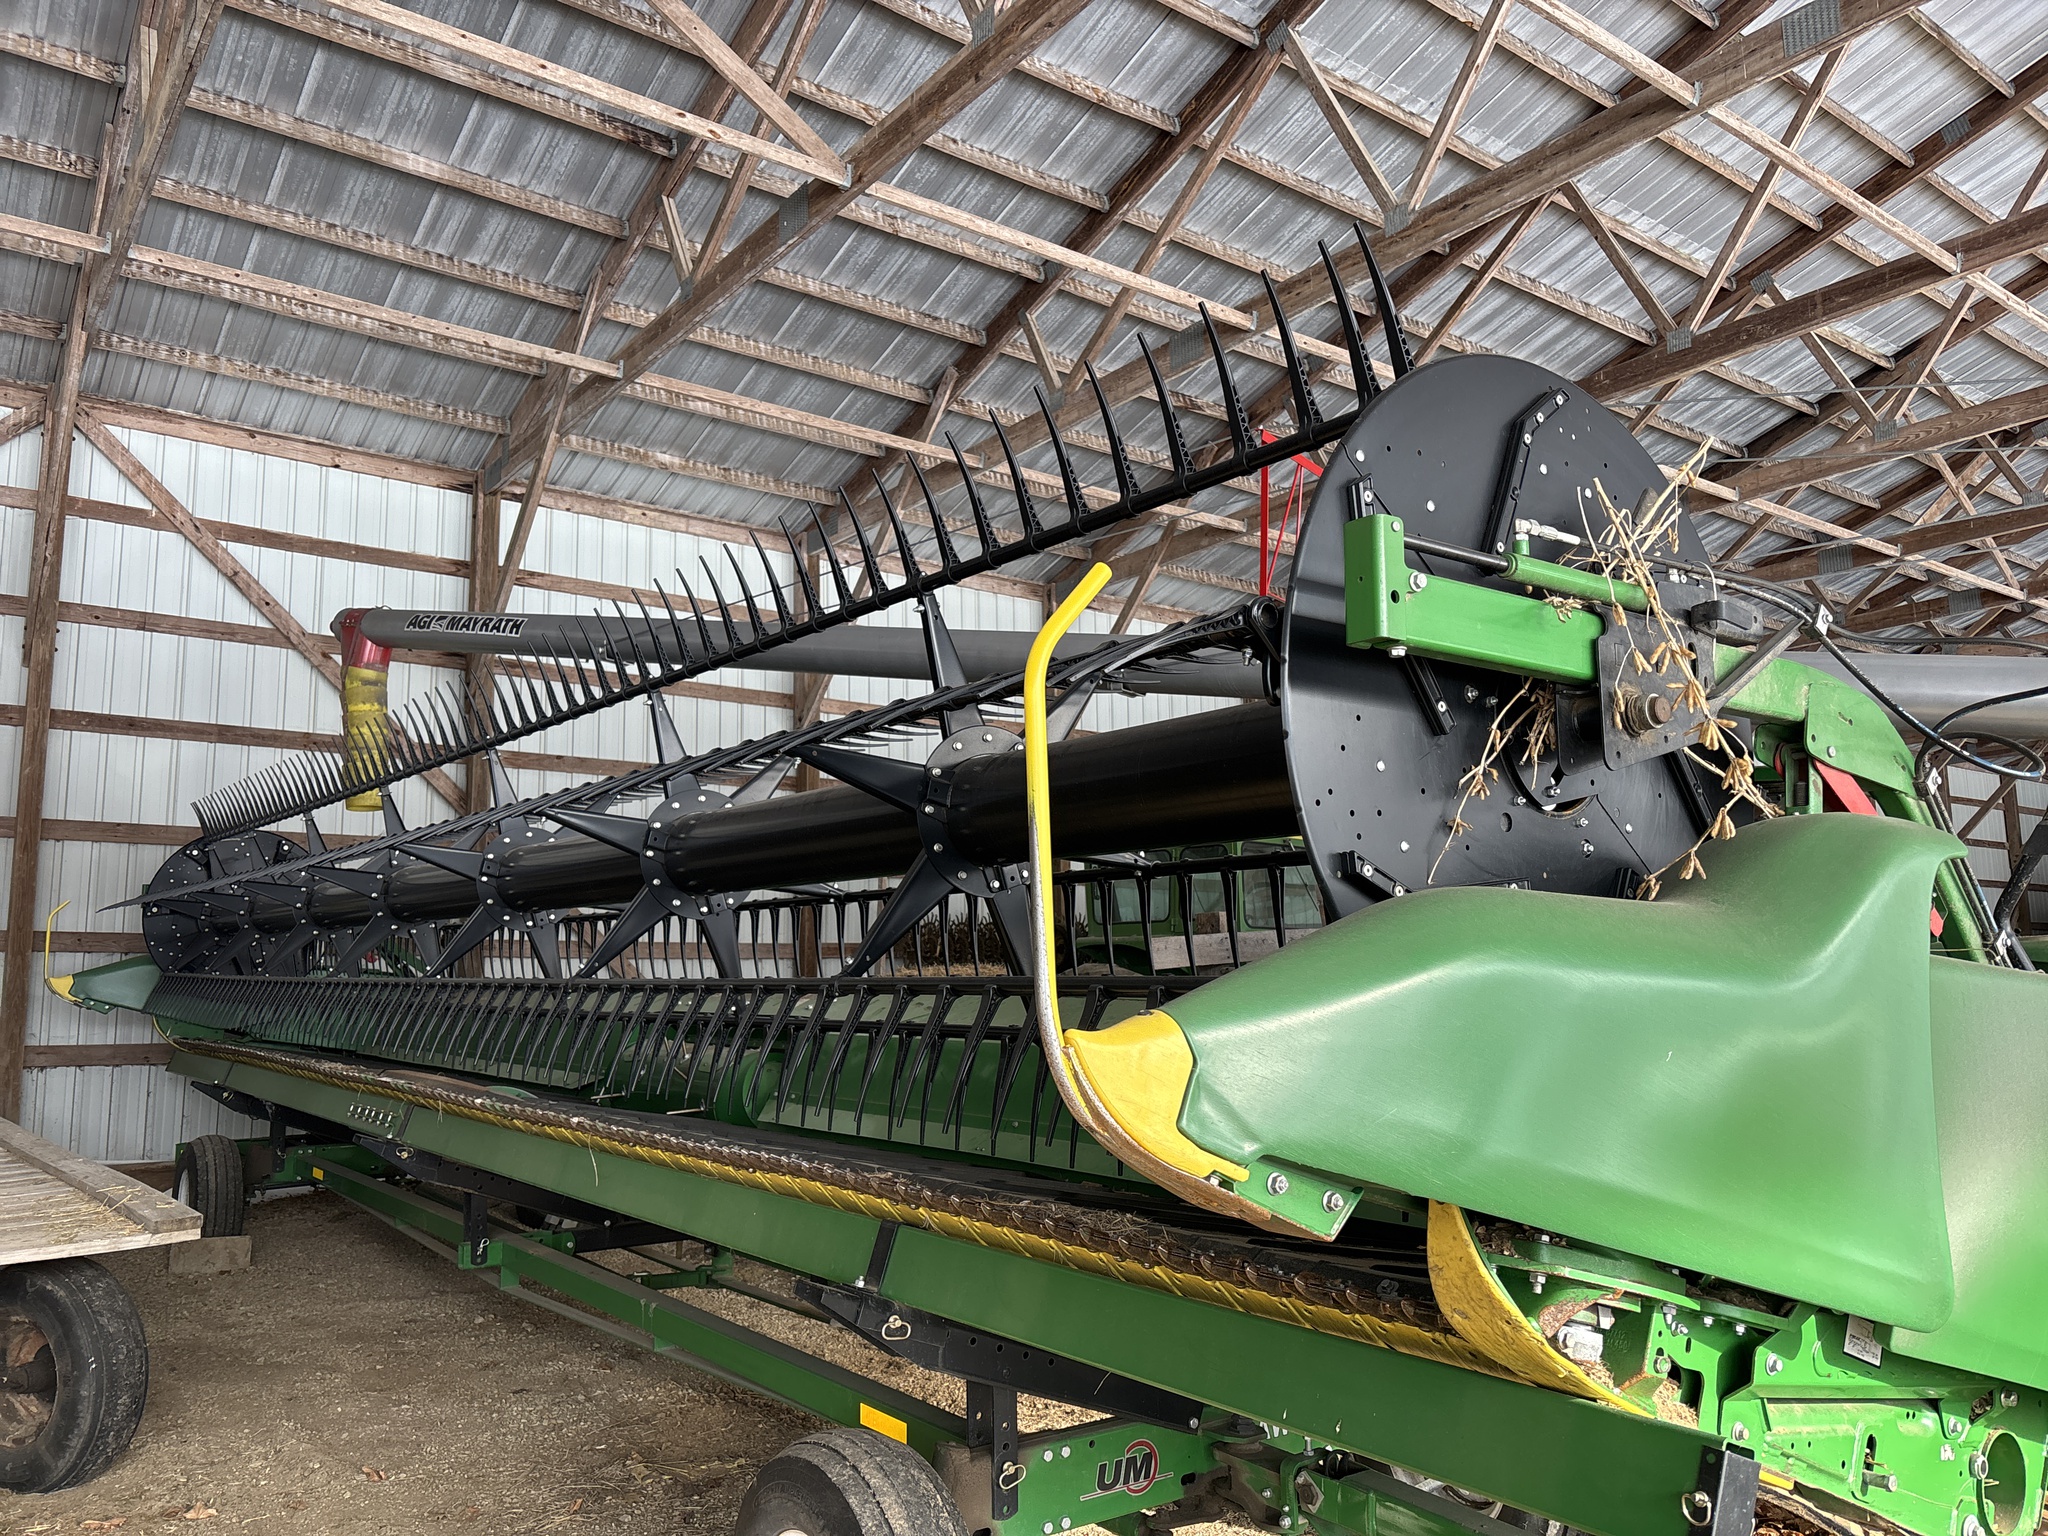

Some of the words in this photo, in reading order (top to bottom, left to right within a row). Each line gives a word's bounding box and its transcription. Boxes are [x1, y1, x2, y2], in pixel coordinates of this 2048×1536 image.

[406, 614, 435, 630] AGI
[445, 616, 526, 635] MAYRATH
[1096, 1450, 1153, 1492] UM
